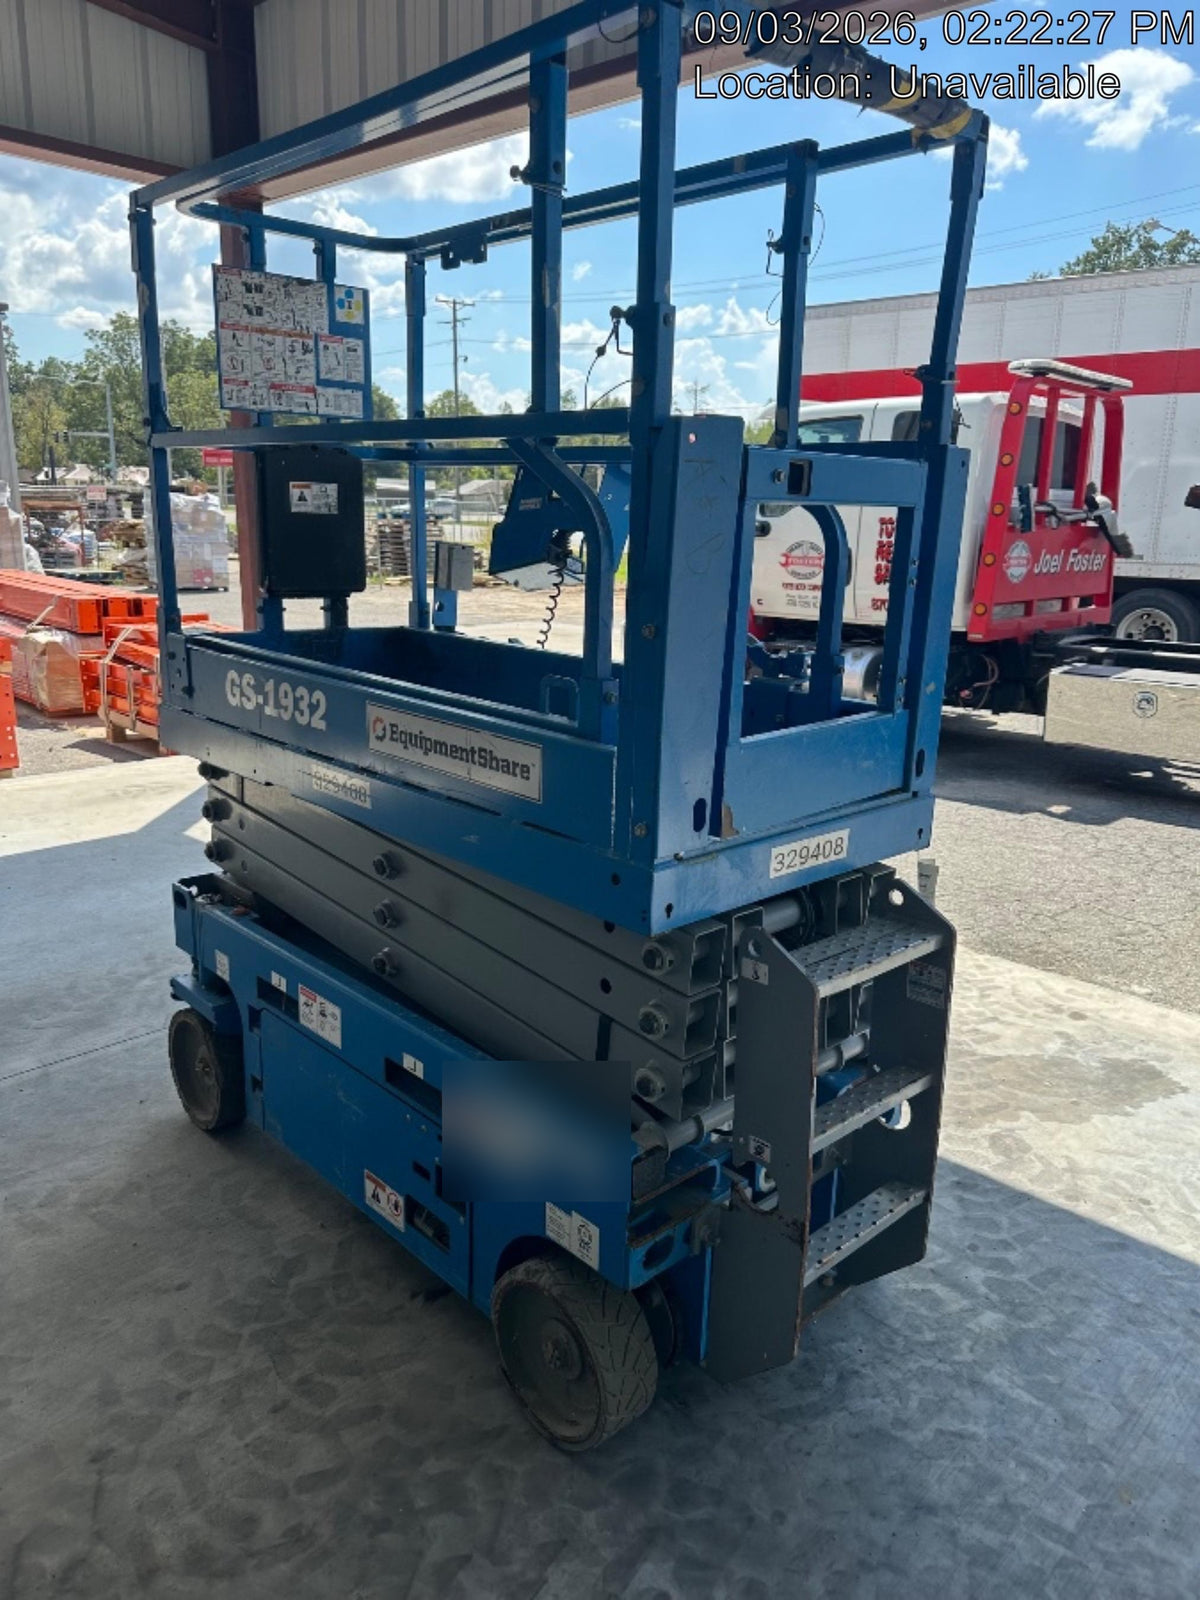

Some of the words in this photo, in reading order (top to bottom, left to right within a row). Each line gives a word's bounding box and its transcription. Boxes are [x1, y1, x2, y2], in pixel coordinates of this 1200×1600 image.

[1033, 549, 1065, 574] Joel
[1066, 548, 1107, 573] Foster
[224, 669, 327, 731] GS-1932
[388, 722, 531, 781] EquipmentShare
[773, 837, 844, 872] 329408
